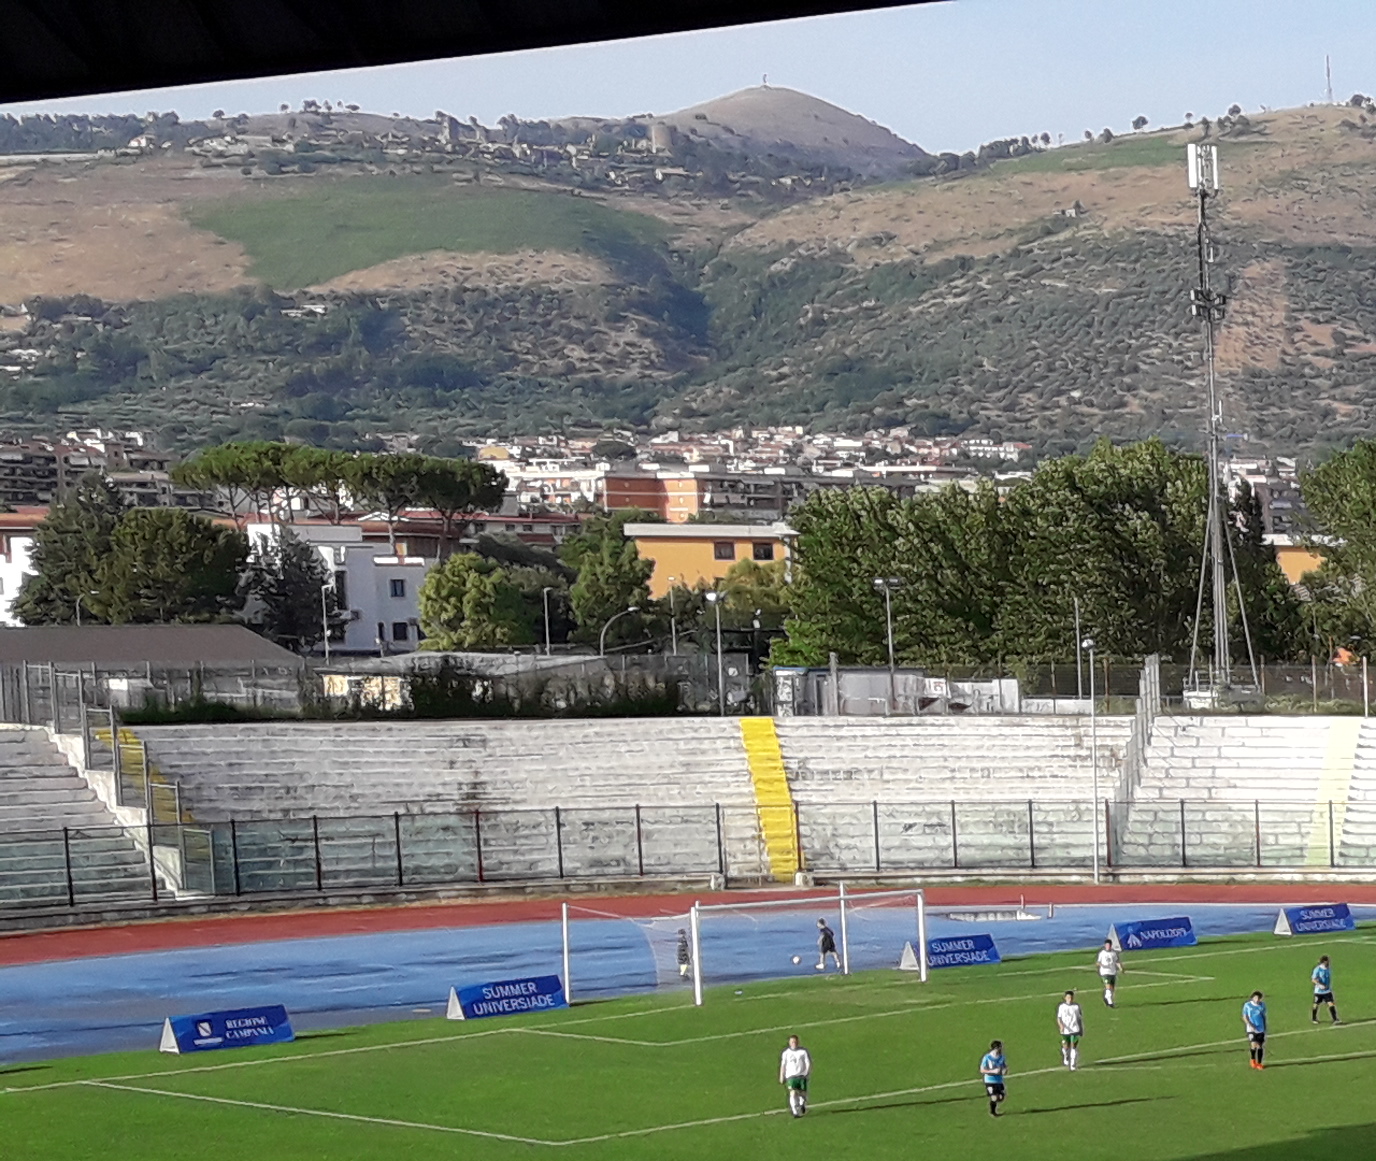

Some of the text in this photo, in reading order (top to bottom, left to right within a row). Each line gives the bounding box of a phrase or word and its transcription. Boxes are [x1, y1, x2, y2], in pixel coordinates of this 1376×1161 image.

[932, 939, 975, 953] SUMMER
[483, 982, 538, 1000] SUMMER
[473, 994, 557, 1016] UNIVERSIADE
